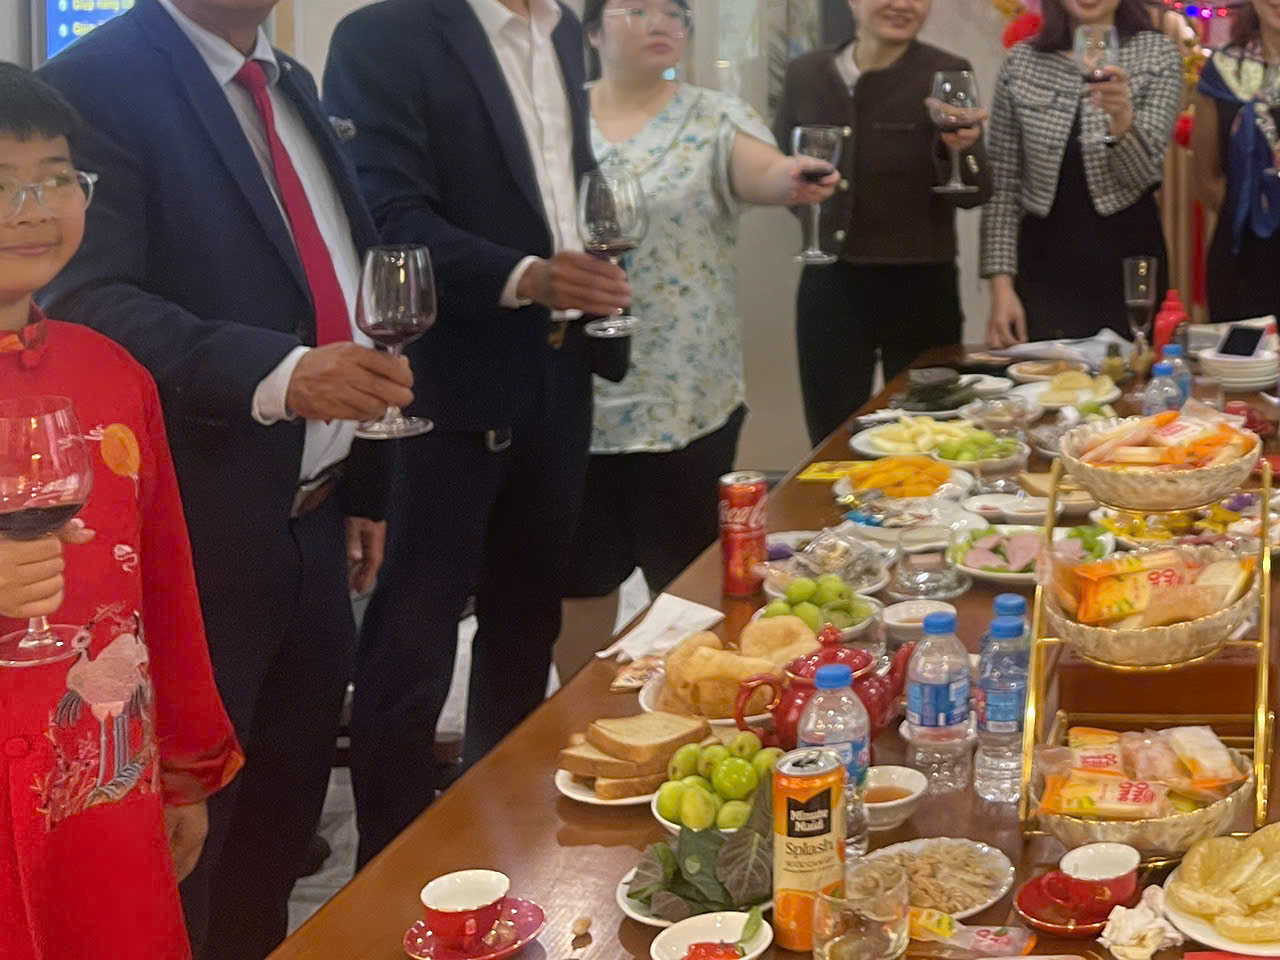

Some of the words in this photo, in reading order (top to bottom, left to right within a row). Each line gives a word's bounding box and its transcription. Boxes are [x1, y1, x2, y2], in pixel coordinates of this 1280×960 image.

[790, 808, 829, 822] Minute
[795, 819, 825, 832] Maid
[785, 838, 835, 860] Splash
